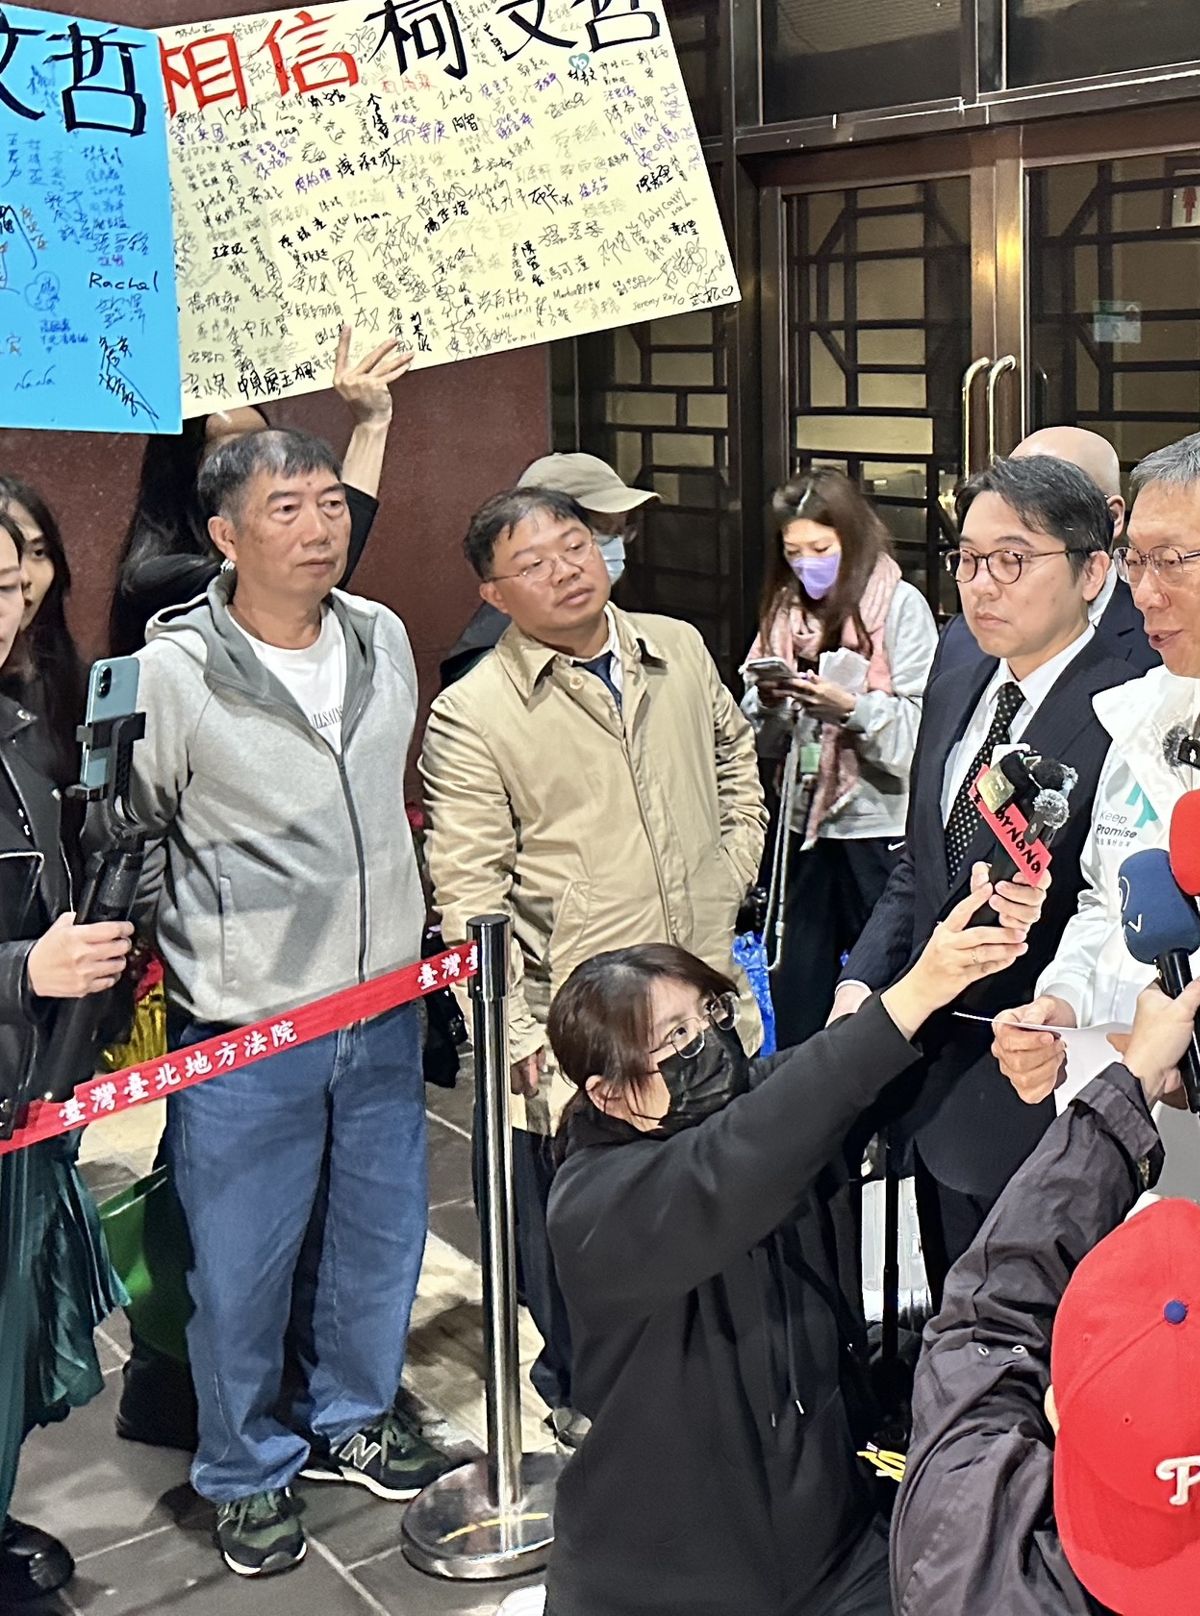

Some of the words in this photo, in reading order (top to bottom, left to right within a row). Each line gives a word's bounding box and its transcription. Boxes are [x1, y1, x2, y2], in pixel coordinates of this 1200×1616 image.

[1095, 823, 1138, 839] Promise
[58, 1020, 298, 1128] 臺灣臺北地方法院
